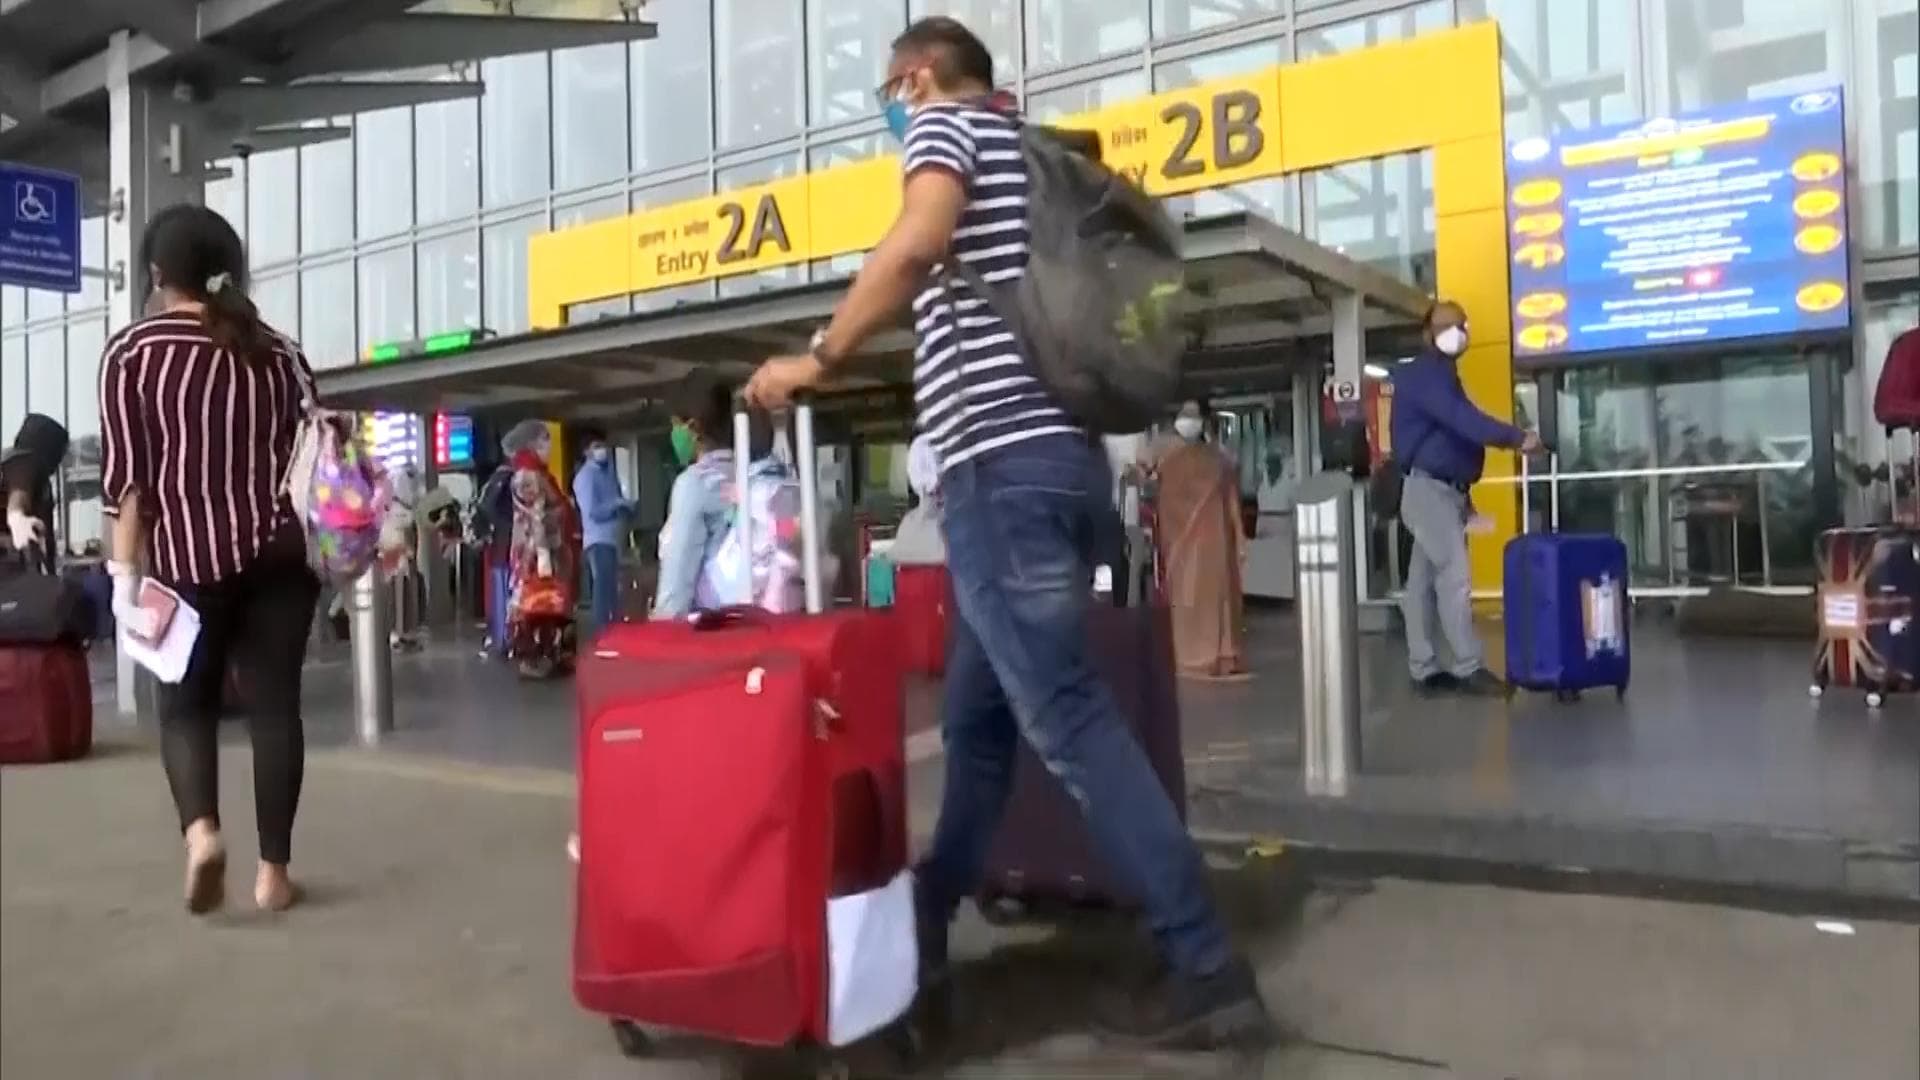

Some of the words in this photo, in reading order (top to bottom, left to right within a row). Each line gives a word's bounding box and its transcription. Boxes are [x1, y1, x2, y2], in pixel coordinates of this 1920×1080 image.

[1161, 88, 1265, 180] 2B
[656, 249, 709, 276] Entry
[716, 193, 791, 265] 2A
